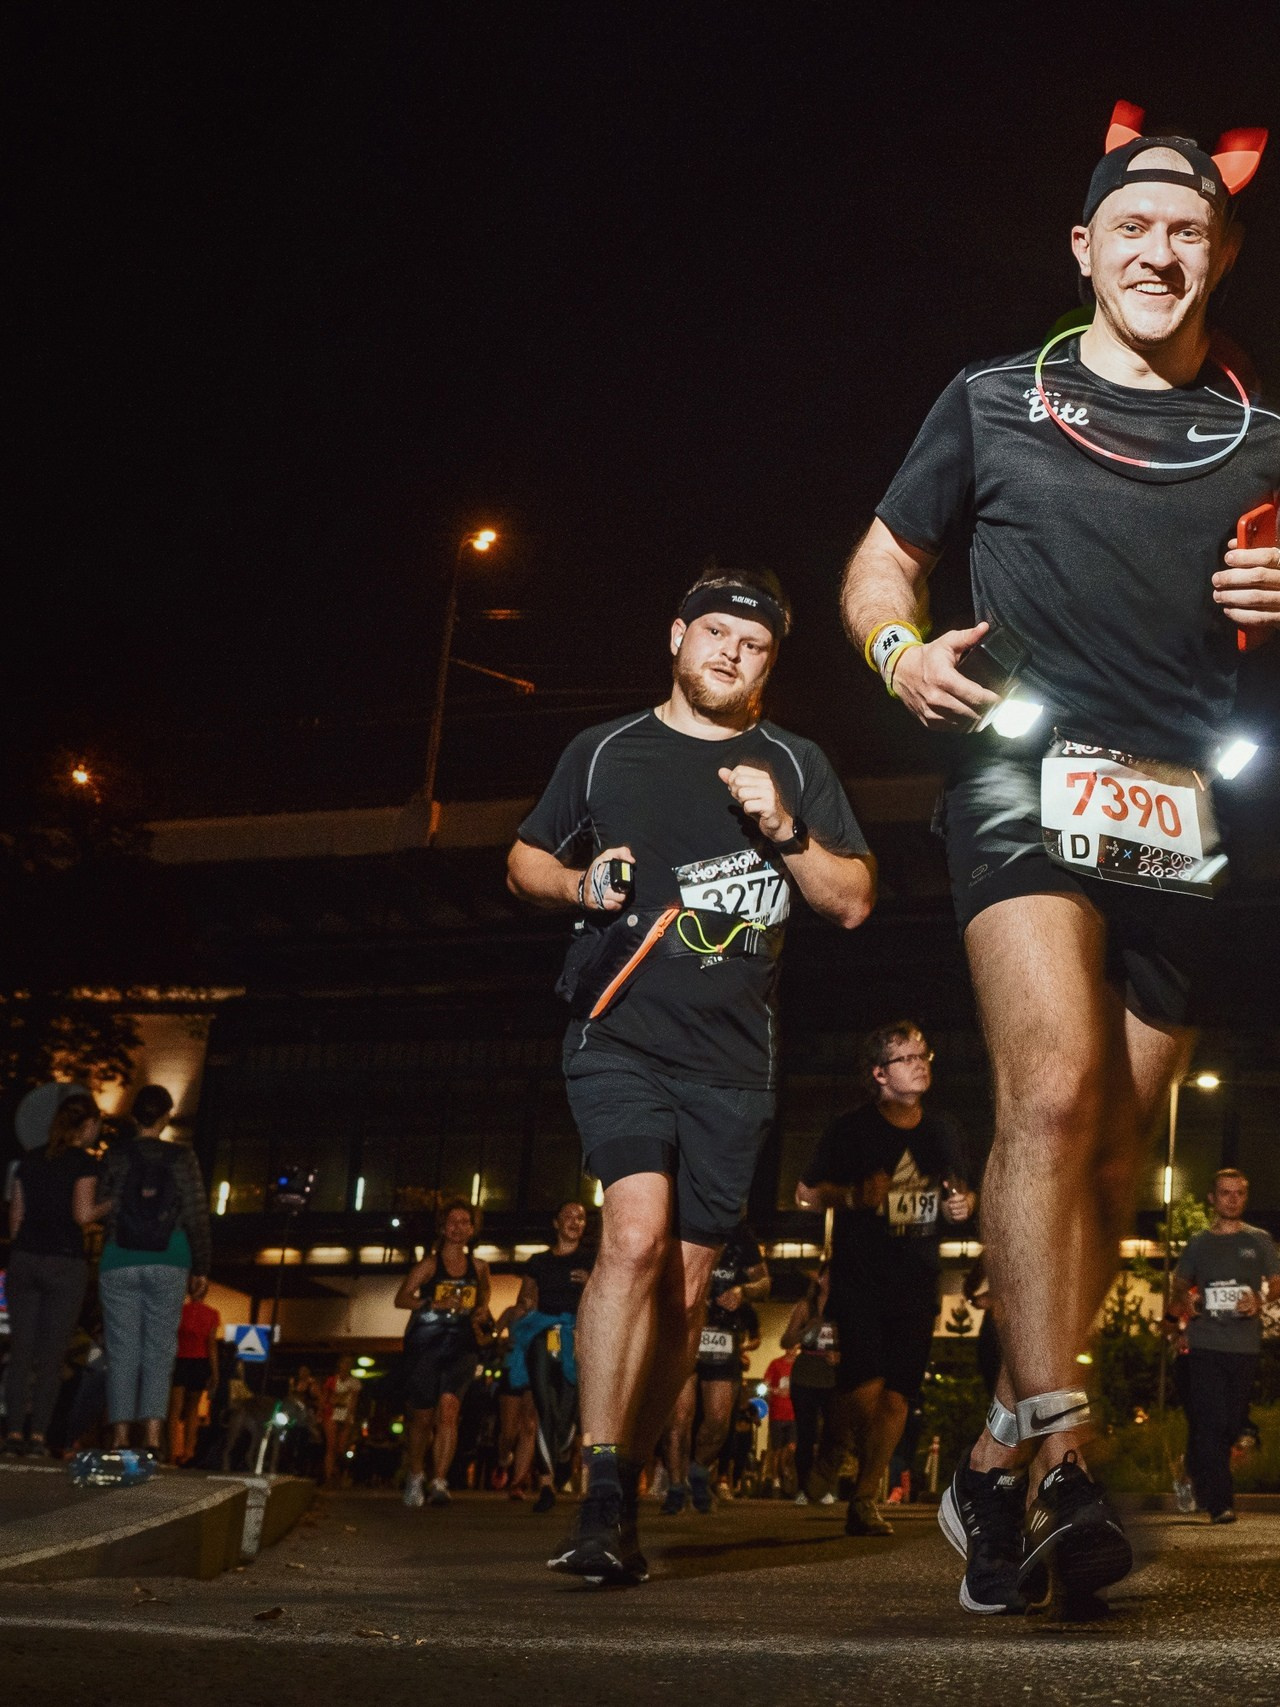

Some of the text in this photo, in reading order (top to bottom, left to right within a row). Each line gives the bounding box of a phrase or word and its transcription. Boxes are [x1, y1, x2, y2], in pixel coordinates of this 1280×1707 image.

[1066, 771, 1182, 838] 7390
[1070, 834, 1091, 859] D
[702, 873, 784, 918] 3277
[996, 1474, 1016, 1486] NIKE
